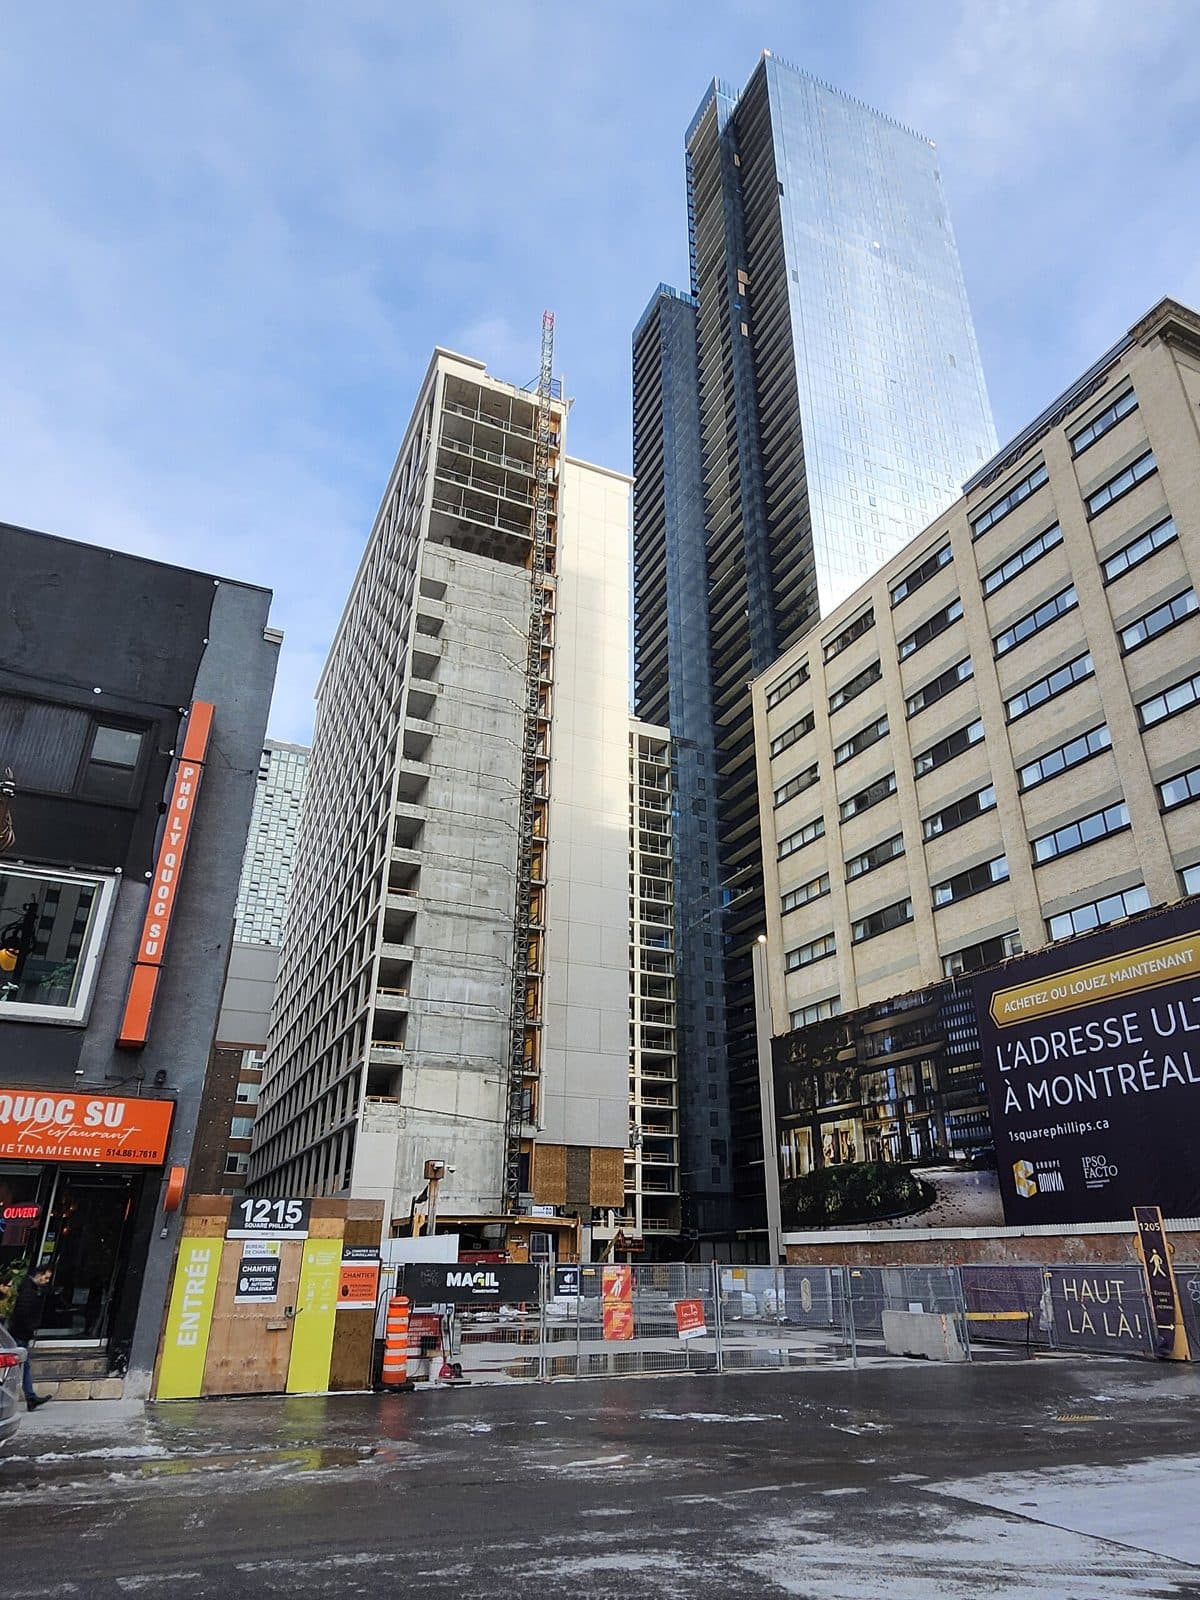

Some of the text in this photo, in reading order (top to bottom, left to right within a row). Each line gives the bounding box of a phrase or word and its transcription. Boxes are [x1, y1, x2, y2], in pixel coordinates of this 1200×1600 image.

[170, 817, 182, 846] LY
[154, 853, 176, 916] QUOC
[145, 924, 161, 956] SU
[1003, 949, 1194, 1014] ACHETEZ OU LOUEZ MAINTENANT
[996, 1012, 1143, 1072] L'ADRESSE
[1004, 1049, 1200, 1115] À MONTRÉAL
[84, 1101, 126, 1127] SU
[17, 1115, 142, 1146] Restaurant
[1008, 1119, 1110, 1143] 1squarephillips.ca
[1082, 1155, 1107, 1168] IPSO
[1084, 1165, 1118, 1179] FACTO
[3, 1207, 39, 1219] OUVERT
[240, 1198, 303, 1224] 1215
[1139, 1222, 1161, 1232] 1205
[242, 1265, 277, 1273] CHANTIER
[446, 1272, 499, 1287] MAGIL
[176, 1247, 211, 1346] ENTRÉE
[1063, 1278, 1124, 1304] HAUT
[1067, 1304, 1096, 1335] LÀ
